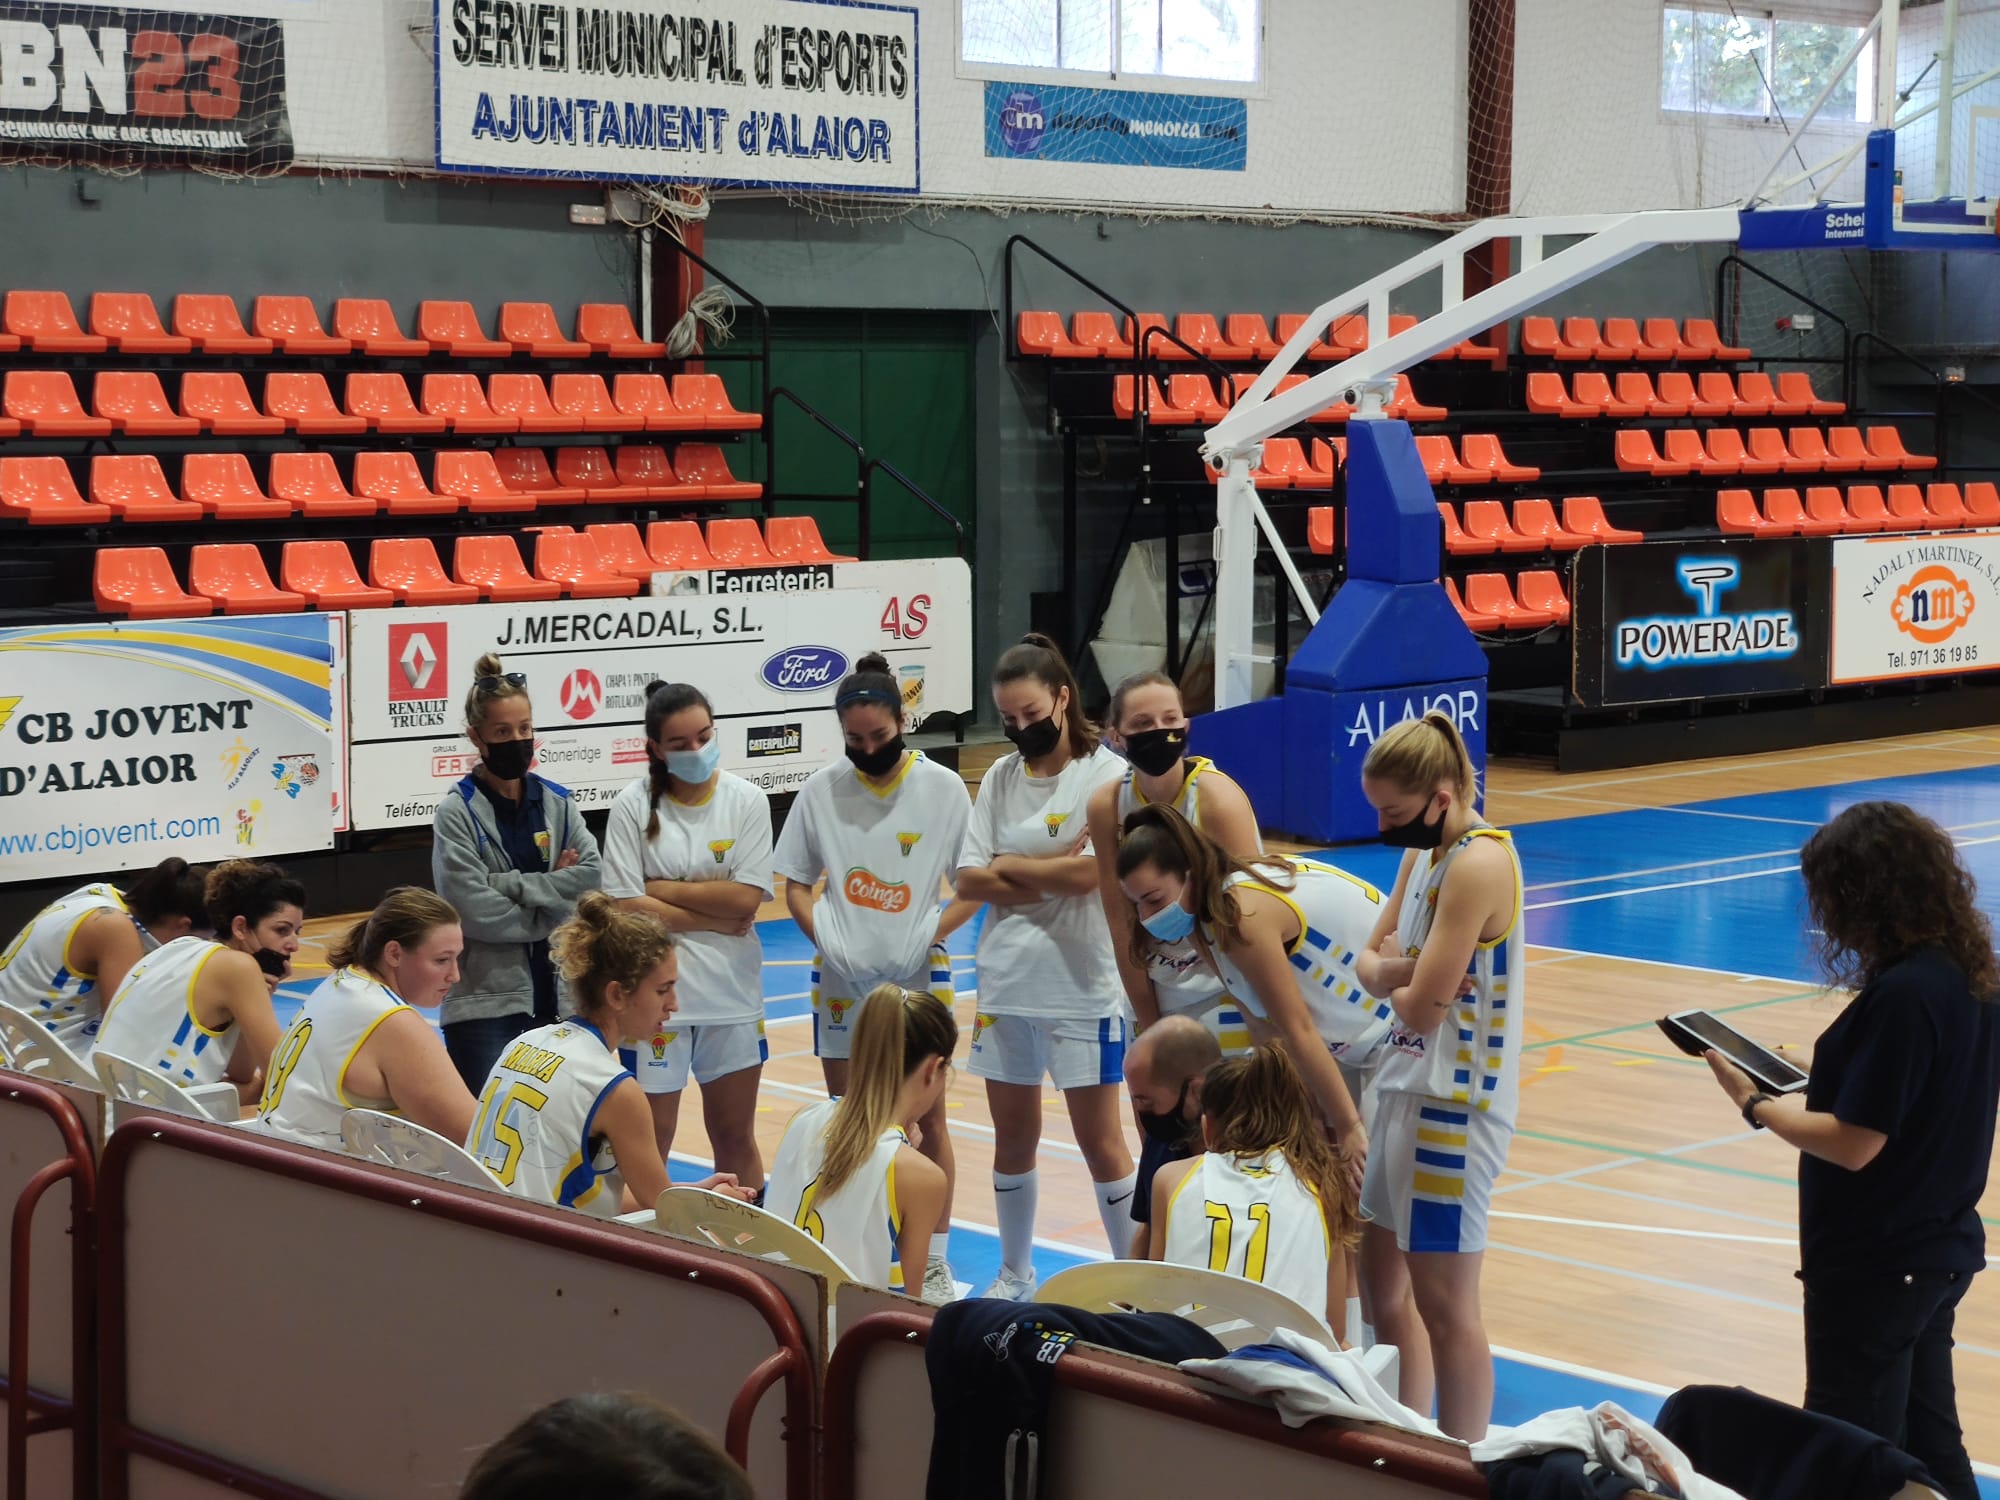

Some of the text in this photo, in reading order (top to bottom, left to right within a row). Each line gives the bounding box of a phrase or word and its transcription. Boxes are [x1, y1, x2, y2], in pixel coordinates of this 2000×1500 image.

[452, 0, 908, 99] SERVEI MUNICIPAL d'ESPORTS
[91, 125, 120, 141] WE
[121, 127, 151, 143] ARE
[151, 128, 248, 148] BASKETBALL
[472, 92, 891, 162] AJUNTAMENT d'ALAIOR
[1862, 554, 1906, 604] NADAL
[497, 607, 763, 645] J.MERCADAL, S.L.
[1620, 618, 1789, 659] POWERADE
[778, 655, 831, 685] Ford
[1888, 645, 1978, 667] Tel. 971 36 19 85
[17, 700, 253, 744] CB JOVENT
[388, 700, 449, 715] RENAULT
[391, 713, 445, 728] TRUCKS
[539, 746, 602, 763] Stoneridge
[748, 735, 800, 752] CATERPILLAR
[470, 1076, 548, 1187] 15
